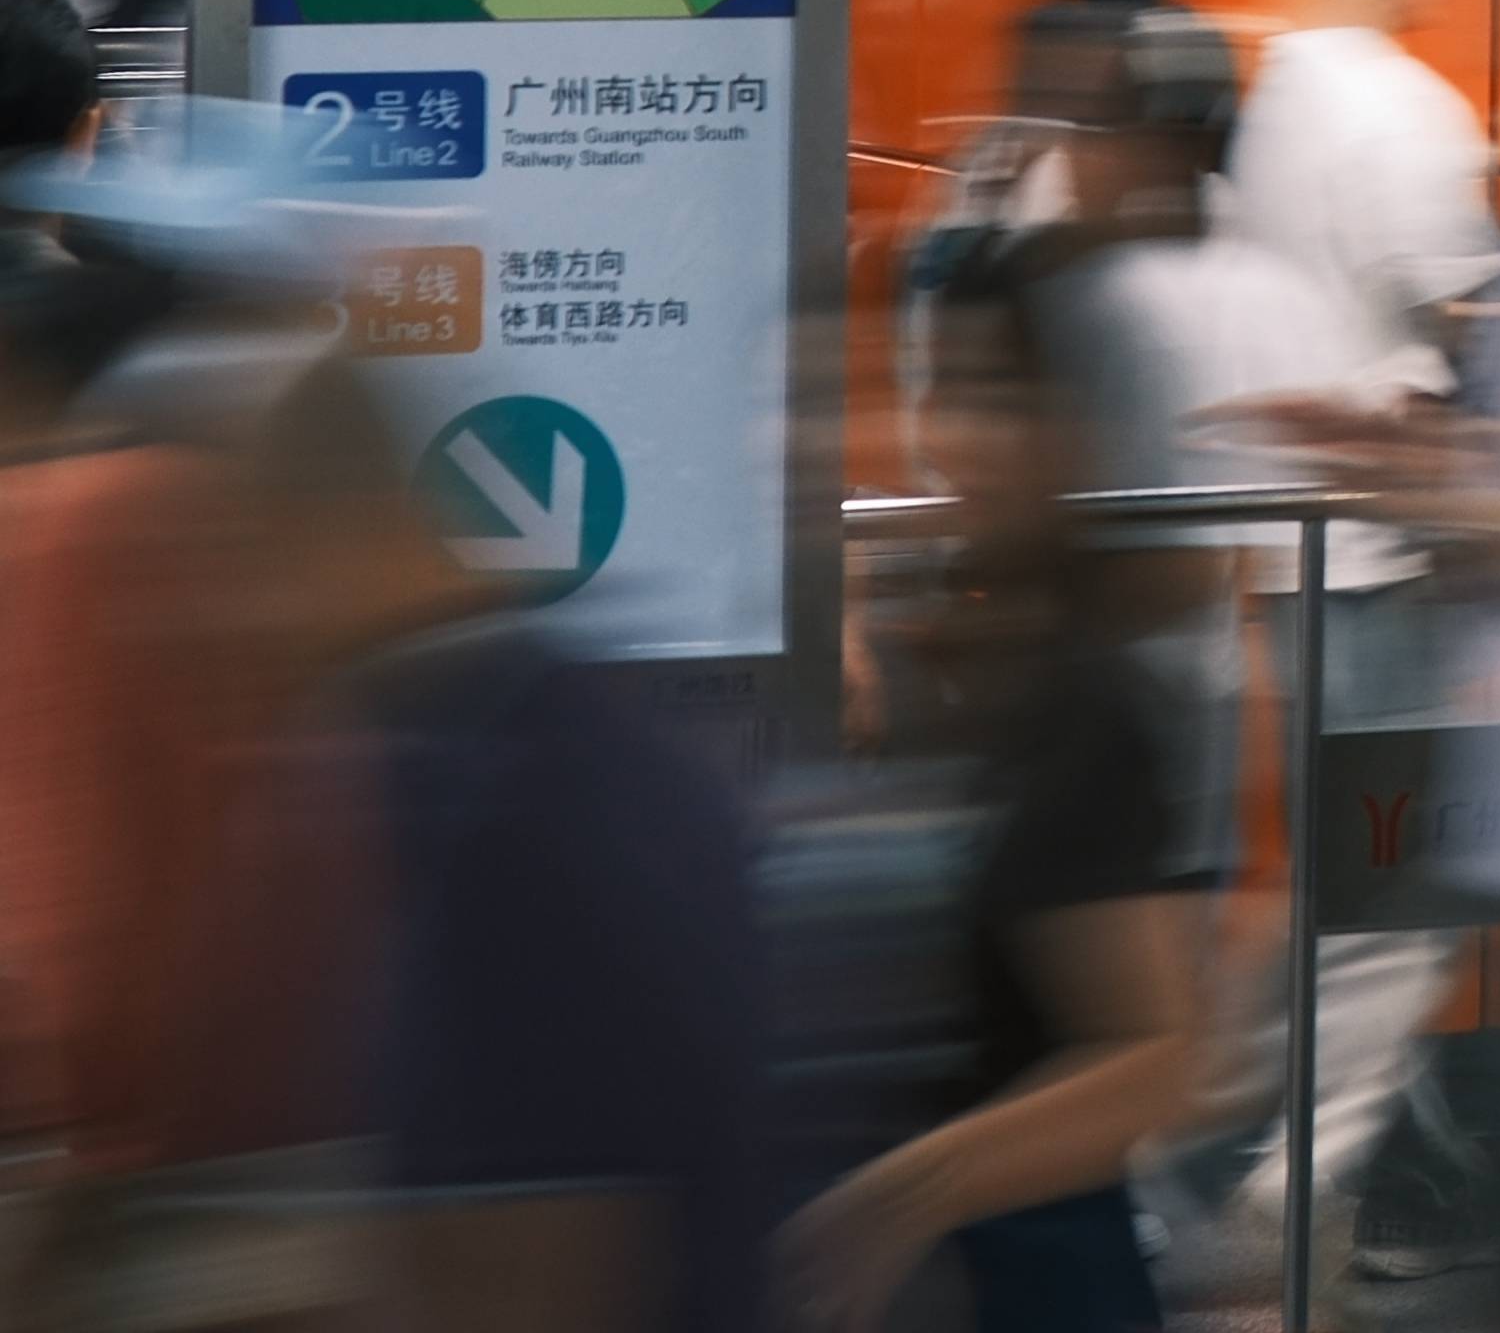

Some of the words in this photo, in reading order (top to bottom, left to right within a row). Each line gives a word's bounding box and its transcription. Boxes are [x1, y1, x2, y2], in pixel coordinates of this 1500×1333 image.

[504, 73, 768, 117] 广州南站方向
[504, 129, 578, 146] Towards
[584, 127, 687, 147] Guangzhou
[693, 125, 748, 142] South
[502, 151, 574, 169] Railway
[579, 149, 645, 165] Station
[500, 248, 626, 280] 海傍方向
[500, 298, 688, 331] 体育西路方向
